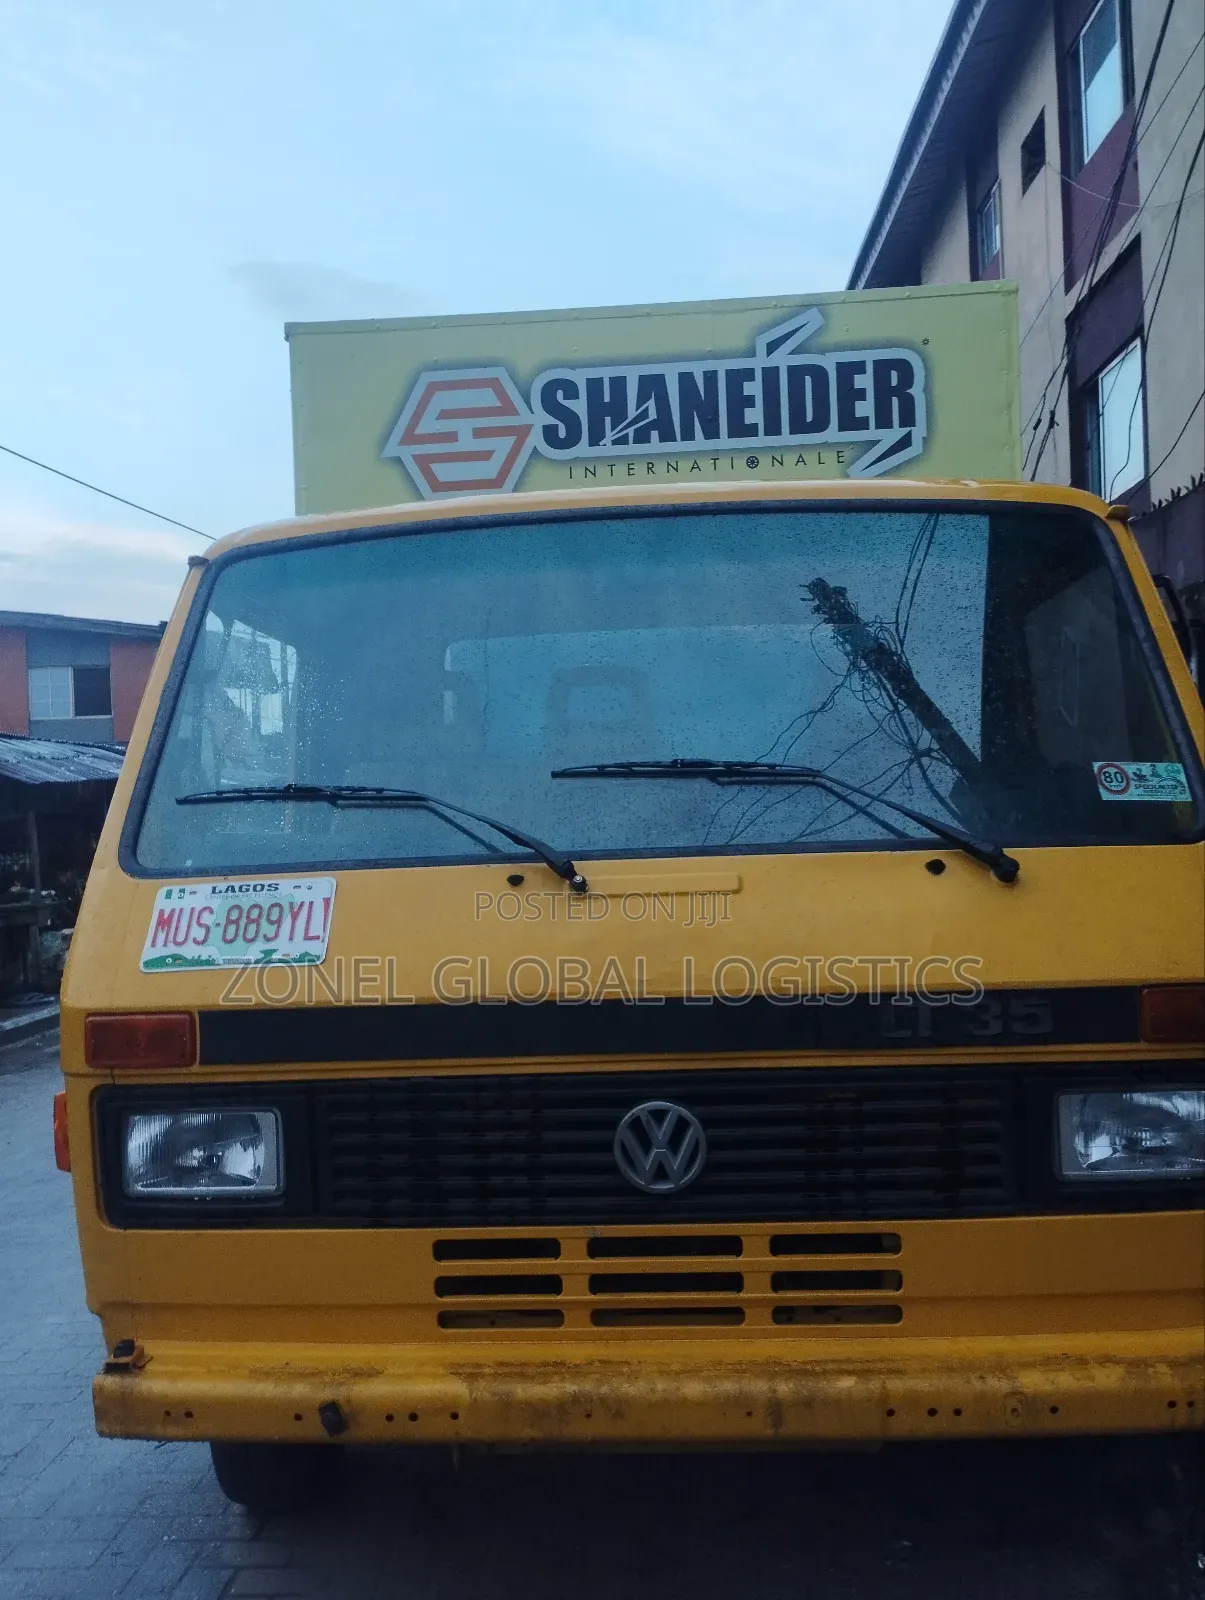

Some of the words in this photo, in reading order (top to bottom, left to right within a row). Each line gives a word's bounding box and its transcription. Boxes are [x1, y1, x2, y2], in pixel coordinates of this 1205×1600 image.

[540, 357, 918, 451] SHANEIDER
[568, 449, 846, 480] INTERNATIONALE
[1102, 771, 1124, 784] 80
[211, 883, 280, 894] LAGOS
[960, 996, 1055, 1037] 35
